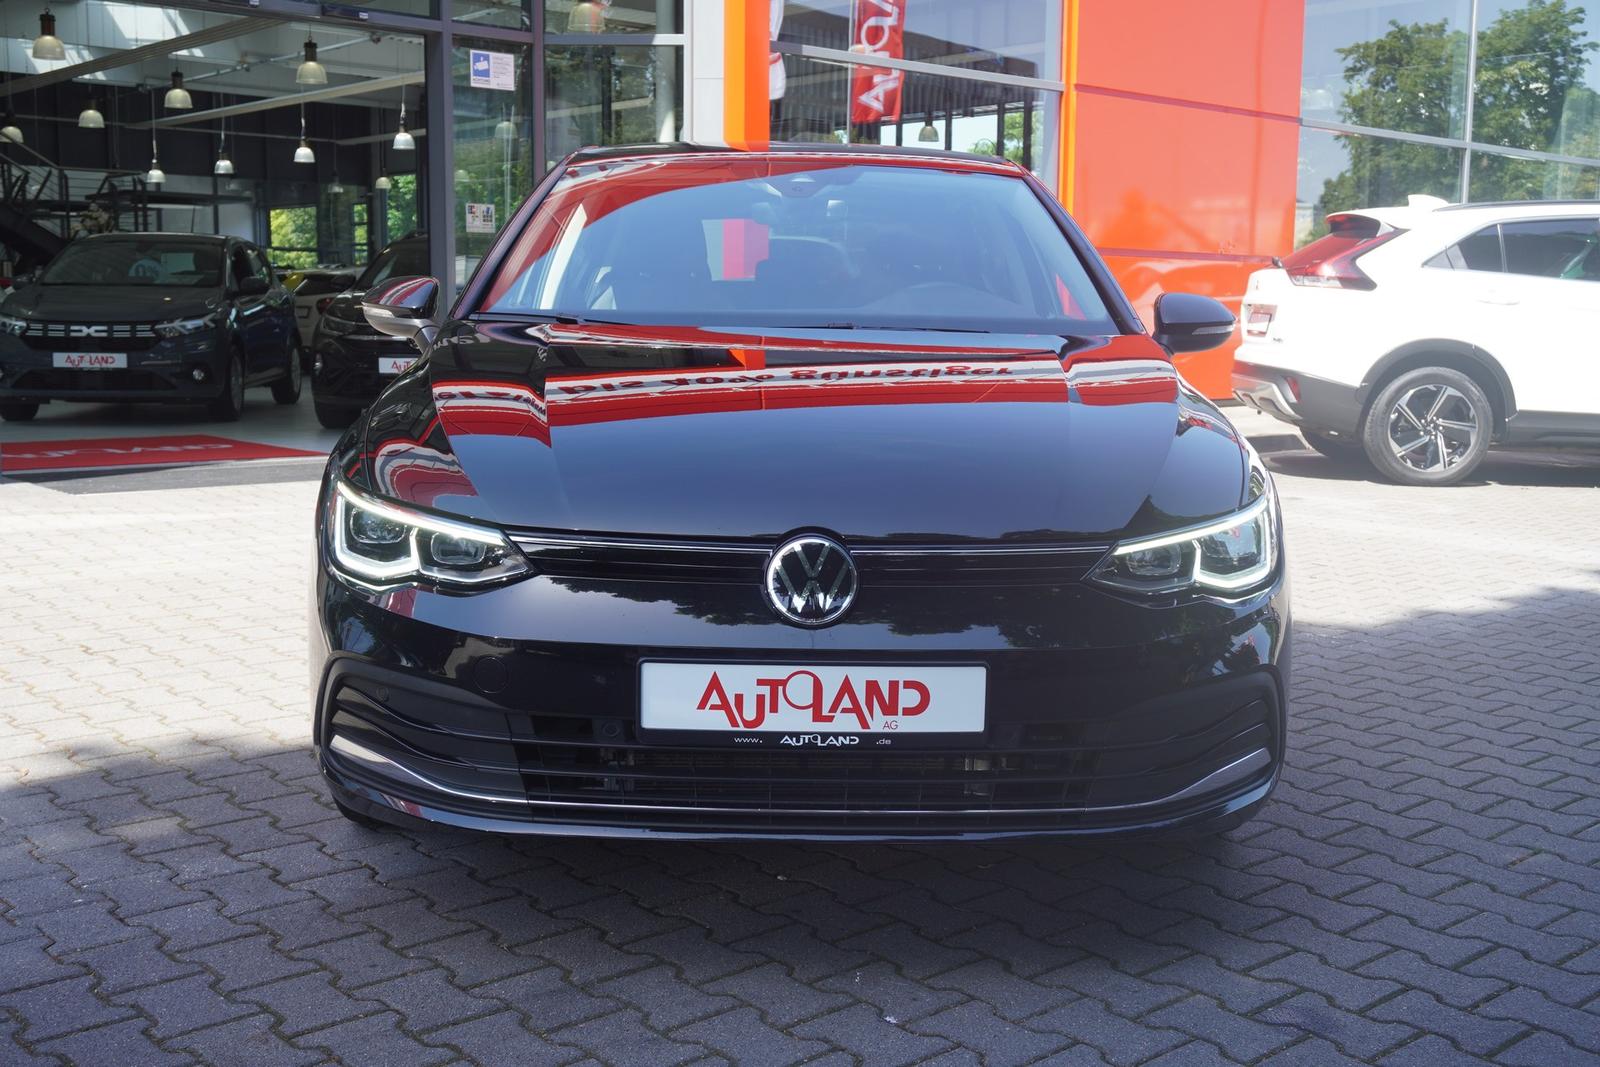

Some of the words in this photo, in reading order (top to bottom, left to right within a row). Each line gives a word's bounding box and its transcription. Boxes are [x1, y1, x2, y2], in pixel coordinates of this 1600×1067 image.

[696, 669, 931, 730] AUTOLAND
[882, 720, 899, 730] AG
[779, 733, 860, 747] AUTOLAND
[876, 737, 892, 745] .de
